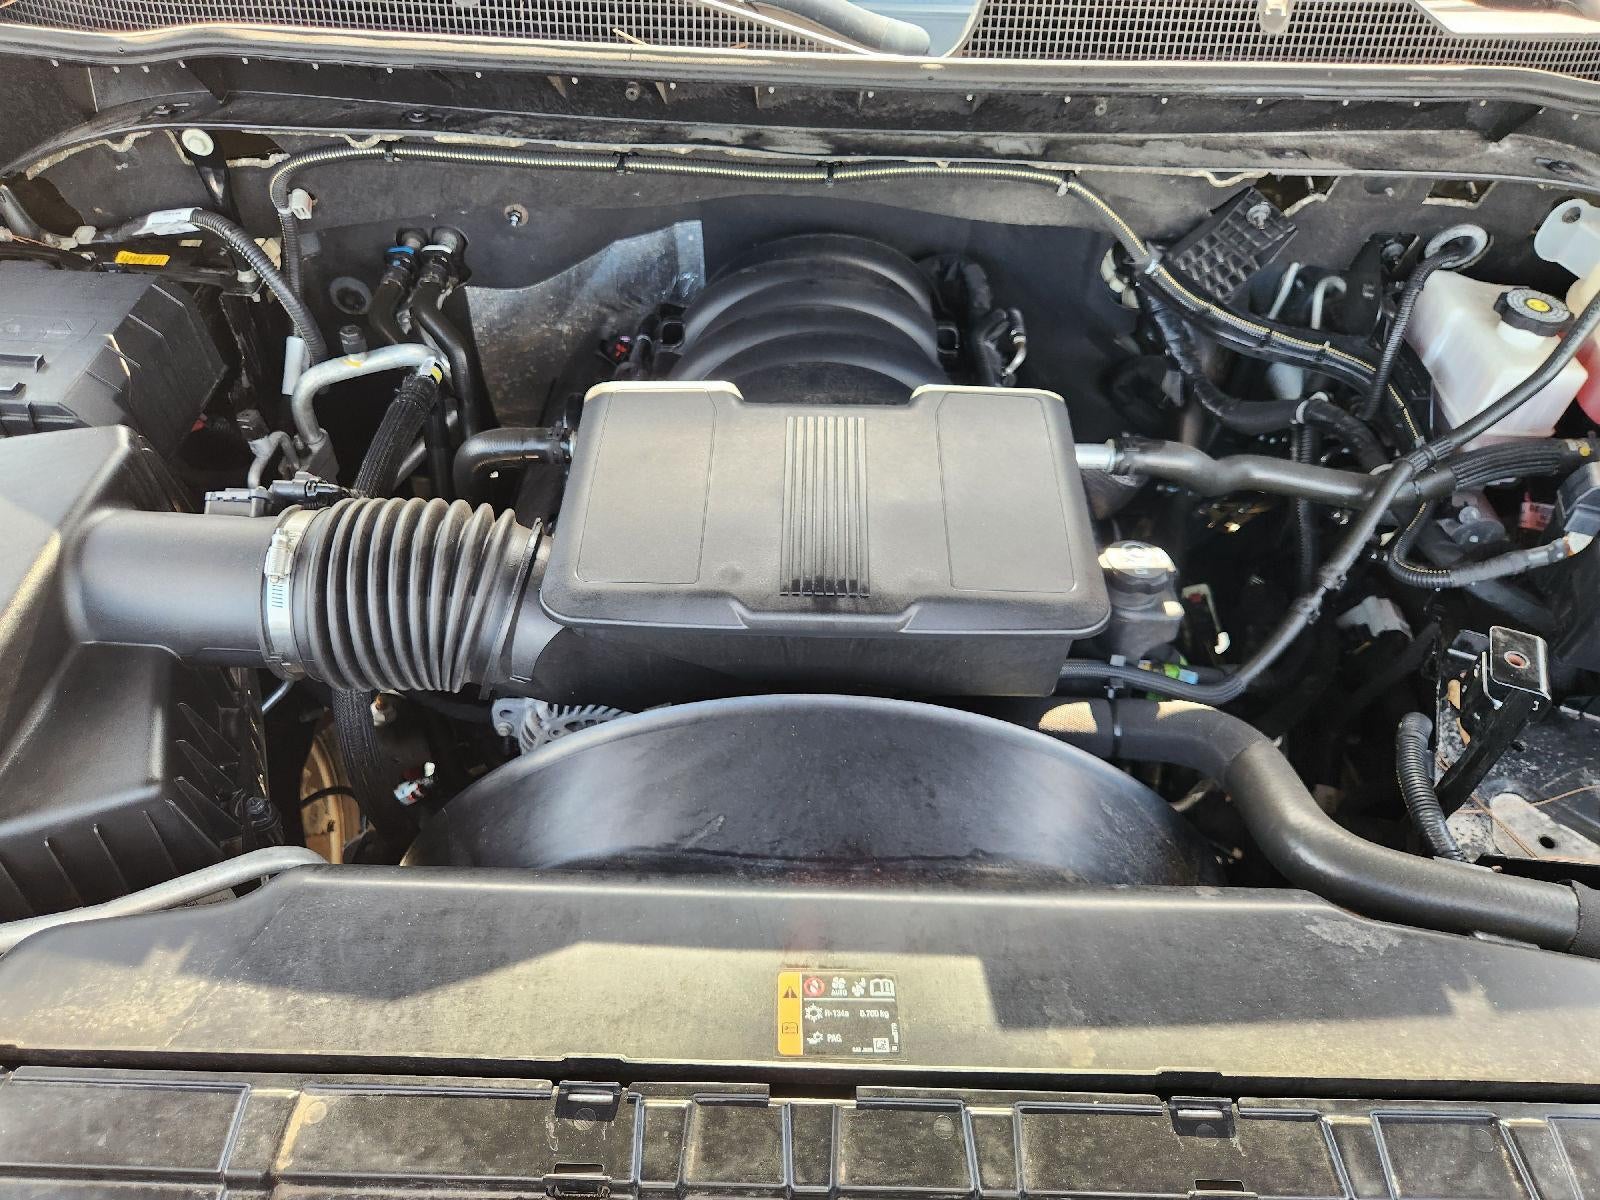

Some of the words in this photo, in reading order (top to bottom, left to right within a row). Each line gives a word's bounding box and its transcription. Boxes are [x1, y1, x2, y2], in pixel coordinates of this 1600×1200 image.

[831, 989, 847, 997] AUTO
[880, 1009, 889, 1019] kg
[826, 1034, 842, 1042] PAG
